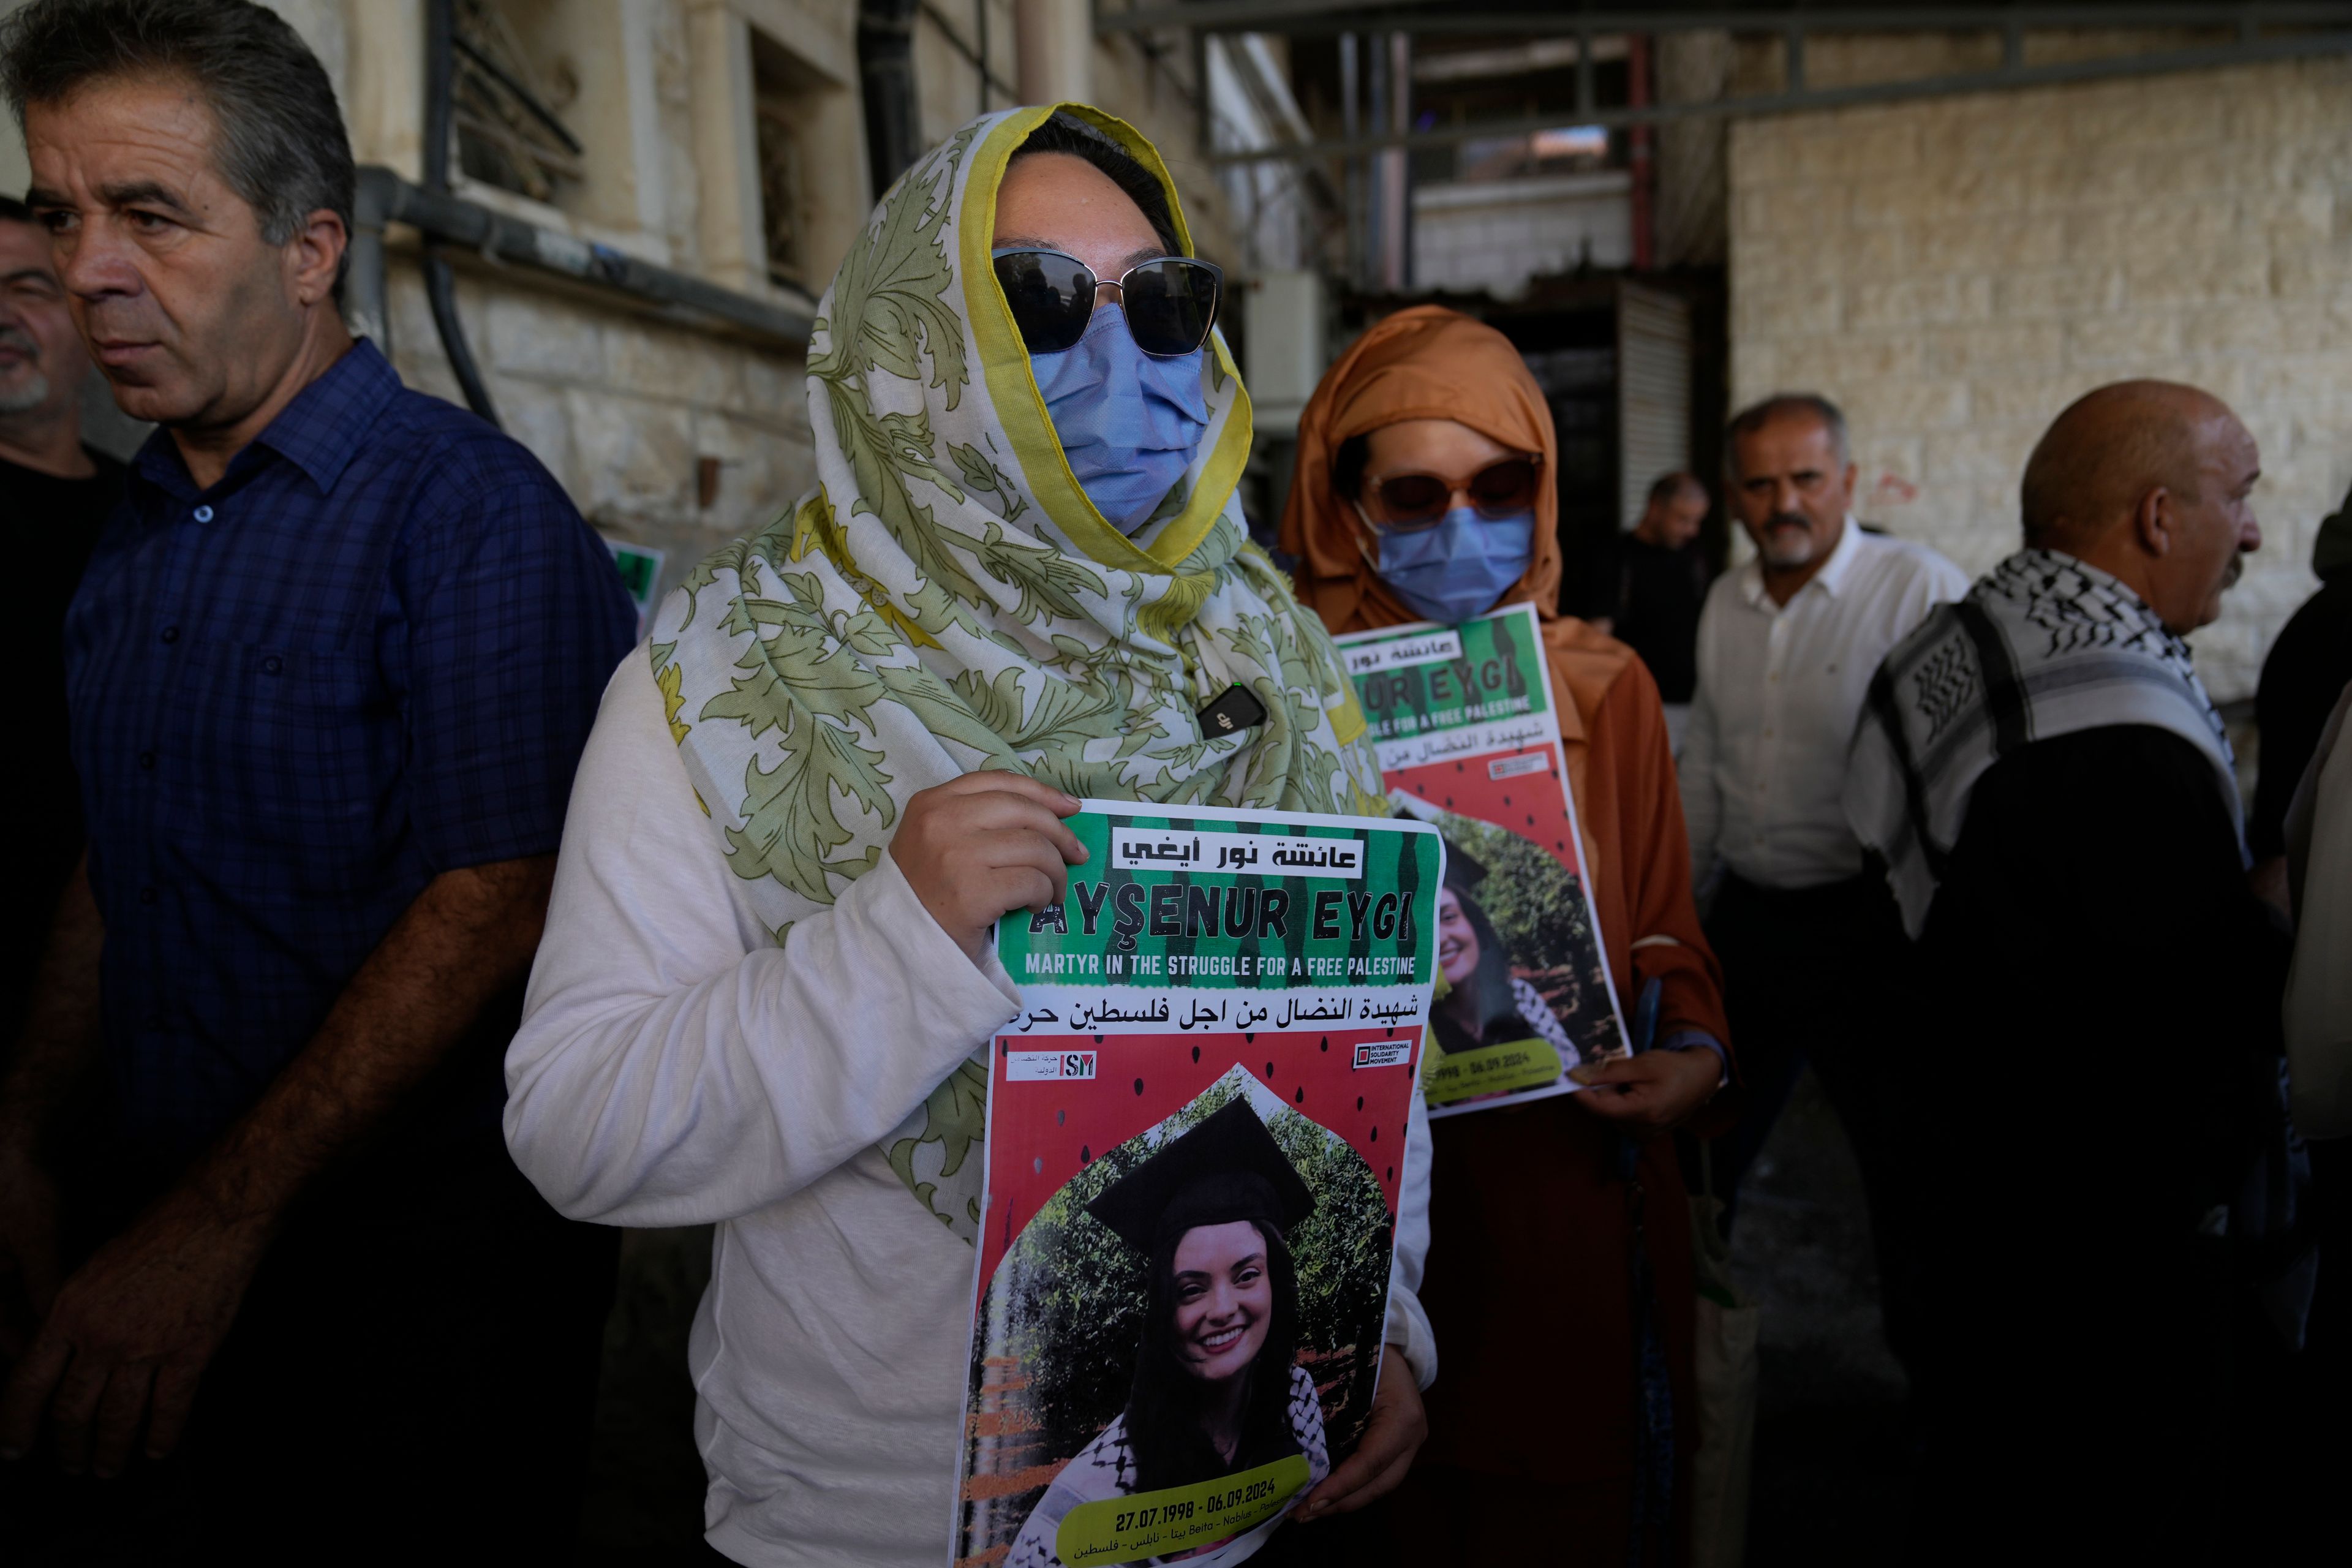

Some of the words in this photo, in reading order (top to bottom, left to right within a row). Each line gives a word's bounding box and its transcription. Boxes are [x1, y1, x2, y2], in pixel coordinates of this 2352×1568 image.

[1429, 657, 1517, 701] EYGI
[1420, 713, 1431, 730] A
[1431, 707, 1464, 728] FREE
[1464, 695, 1530, 720] PALESTINE
[1122, 836, 1200, 867] أيغي
[1216, 840, 1258, 870] نور
[1272, 842, 1355, 869] عائشة
[1028, 880, 1290, 951] AYŞENUR
[1313, 890, 1412, 941] EYGI
[1025, 953, 1099, 974] MARTYR
[1106, 954, 1123, 974] IN
[1130, 955, 1161, 975] THE
[1168, 956, 1250, 975] STRUGGLE
[1257, 957, 1286, 976] FOR
[1291, 957, 1302, 976] A
[1308, 957, 1343, 976] FREE
[1348, 957, 1416, 976] PALESTINE
[1070, 997, 1169, 1030] فلسطين
[1179, 998, 1226, 1030] اجل
[1236, 1000, 1268, 1029] من
[1276, 997, 1352, 1028] النضال
[1360, 995, 1418, 1025] شهيدة
[1060, 1054, 1093, 1077] ISM
[1116, 1501, 1194, 1532] 27.07.1998
[1207, 1477, 1275, 1513] 06.09.2024
[1189, 1522, 1213, 1536] Beita
[1224, 1510, 1251, 1526] Nablus
[1074, 1539, 1119, 1559] فلسطين
[1130, 1532, 1159, 1550] نابلس
